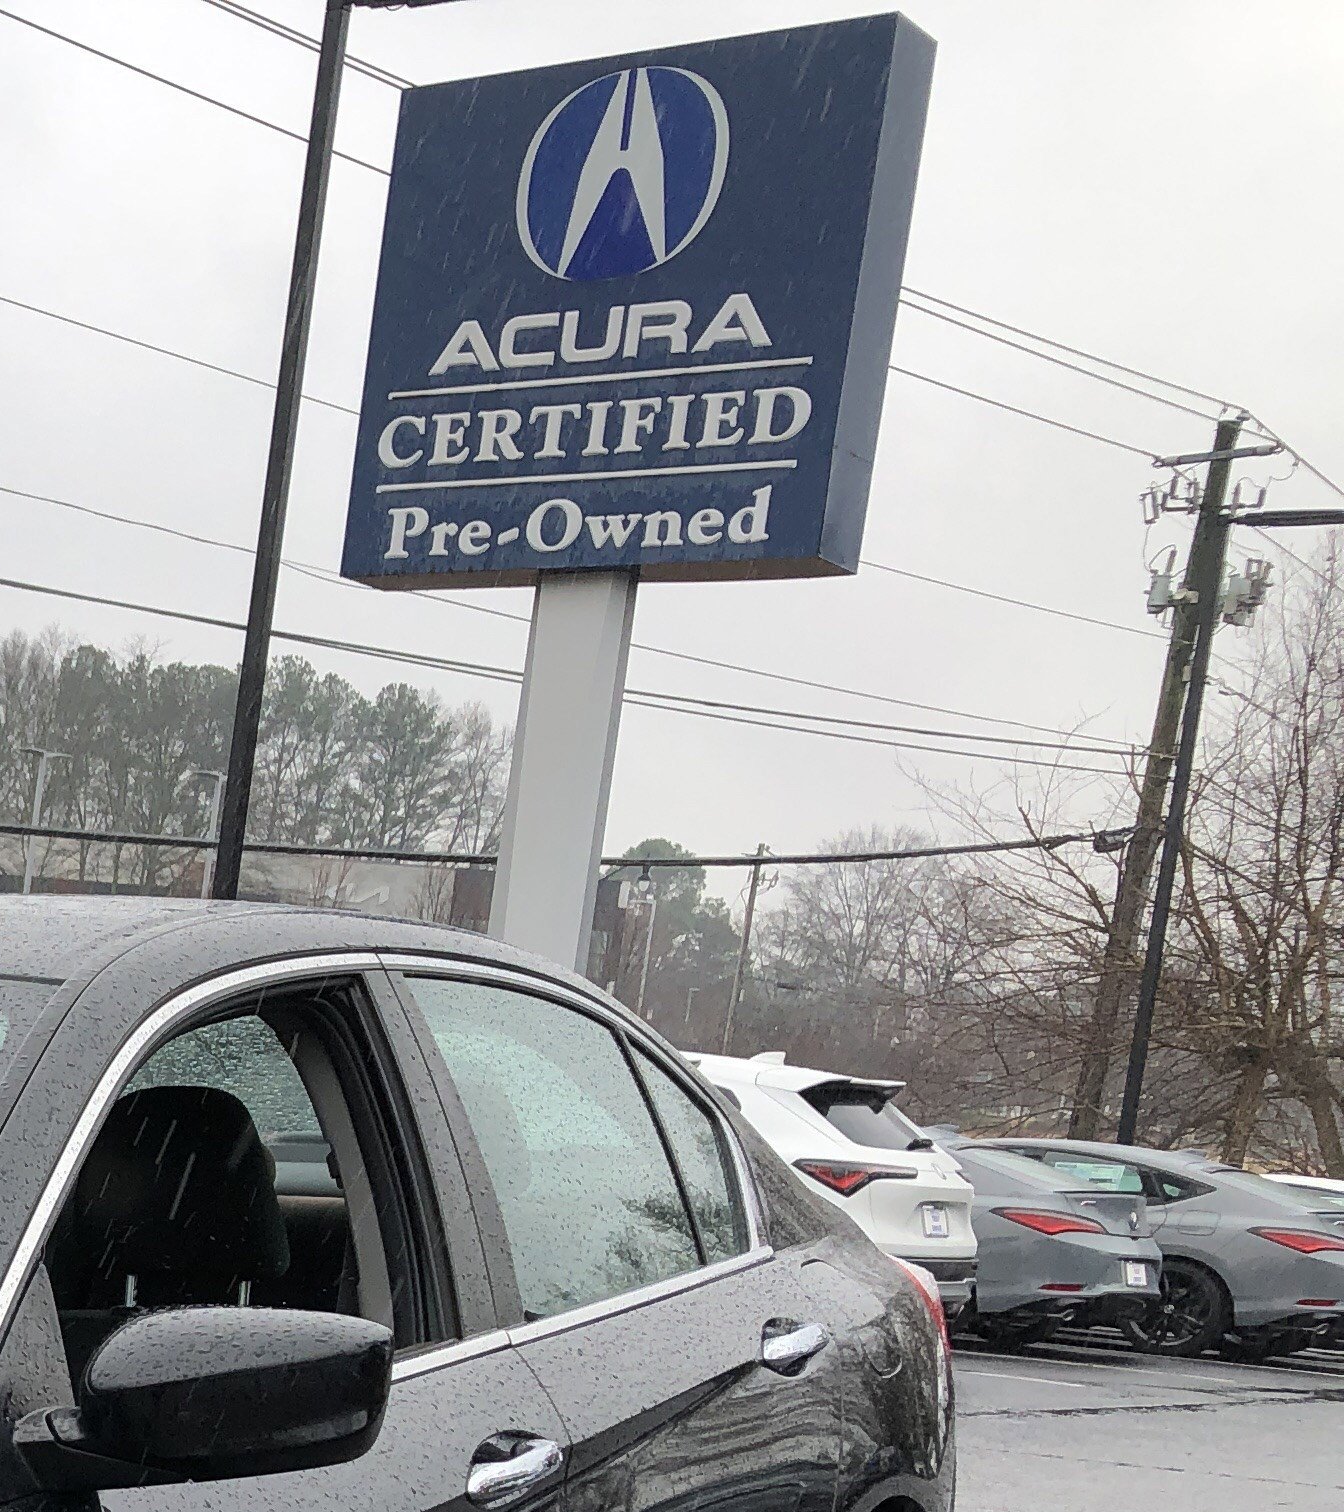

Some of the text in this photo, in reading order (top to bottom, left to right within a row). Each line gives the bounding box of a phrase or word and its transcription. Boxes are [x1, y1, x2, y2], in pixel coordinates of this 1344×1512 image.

[428, 293, 773, 377] ACURA
[376, 386, 813, 469] CERTIFIED
[384, 485, 771, 560] Pre-Owned
